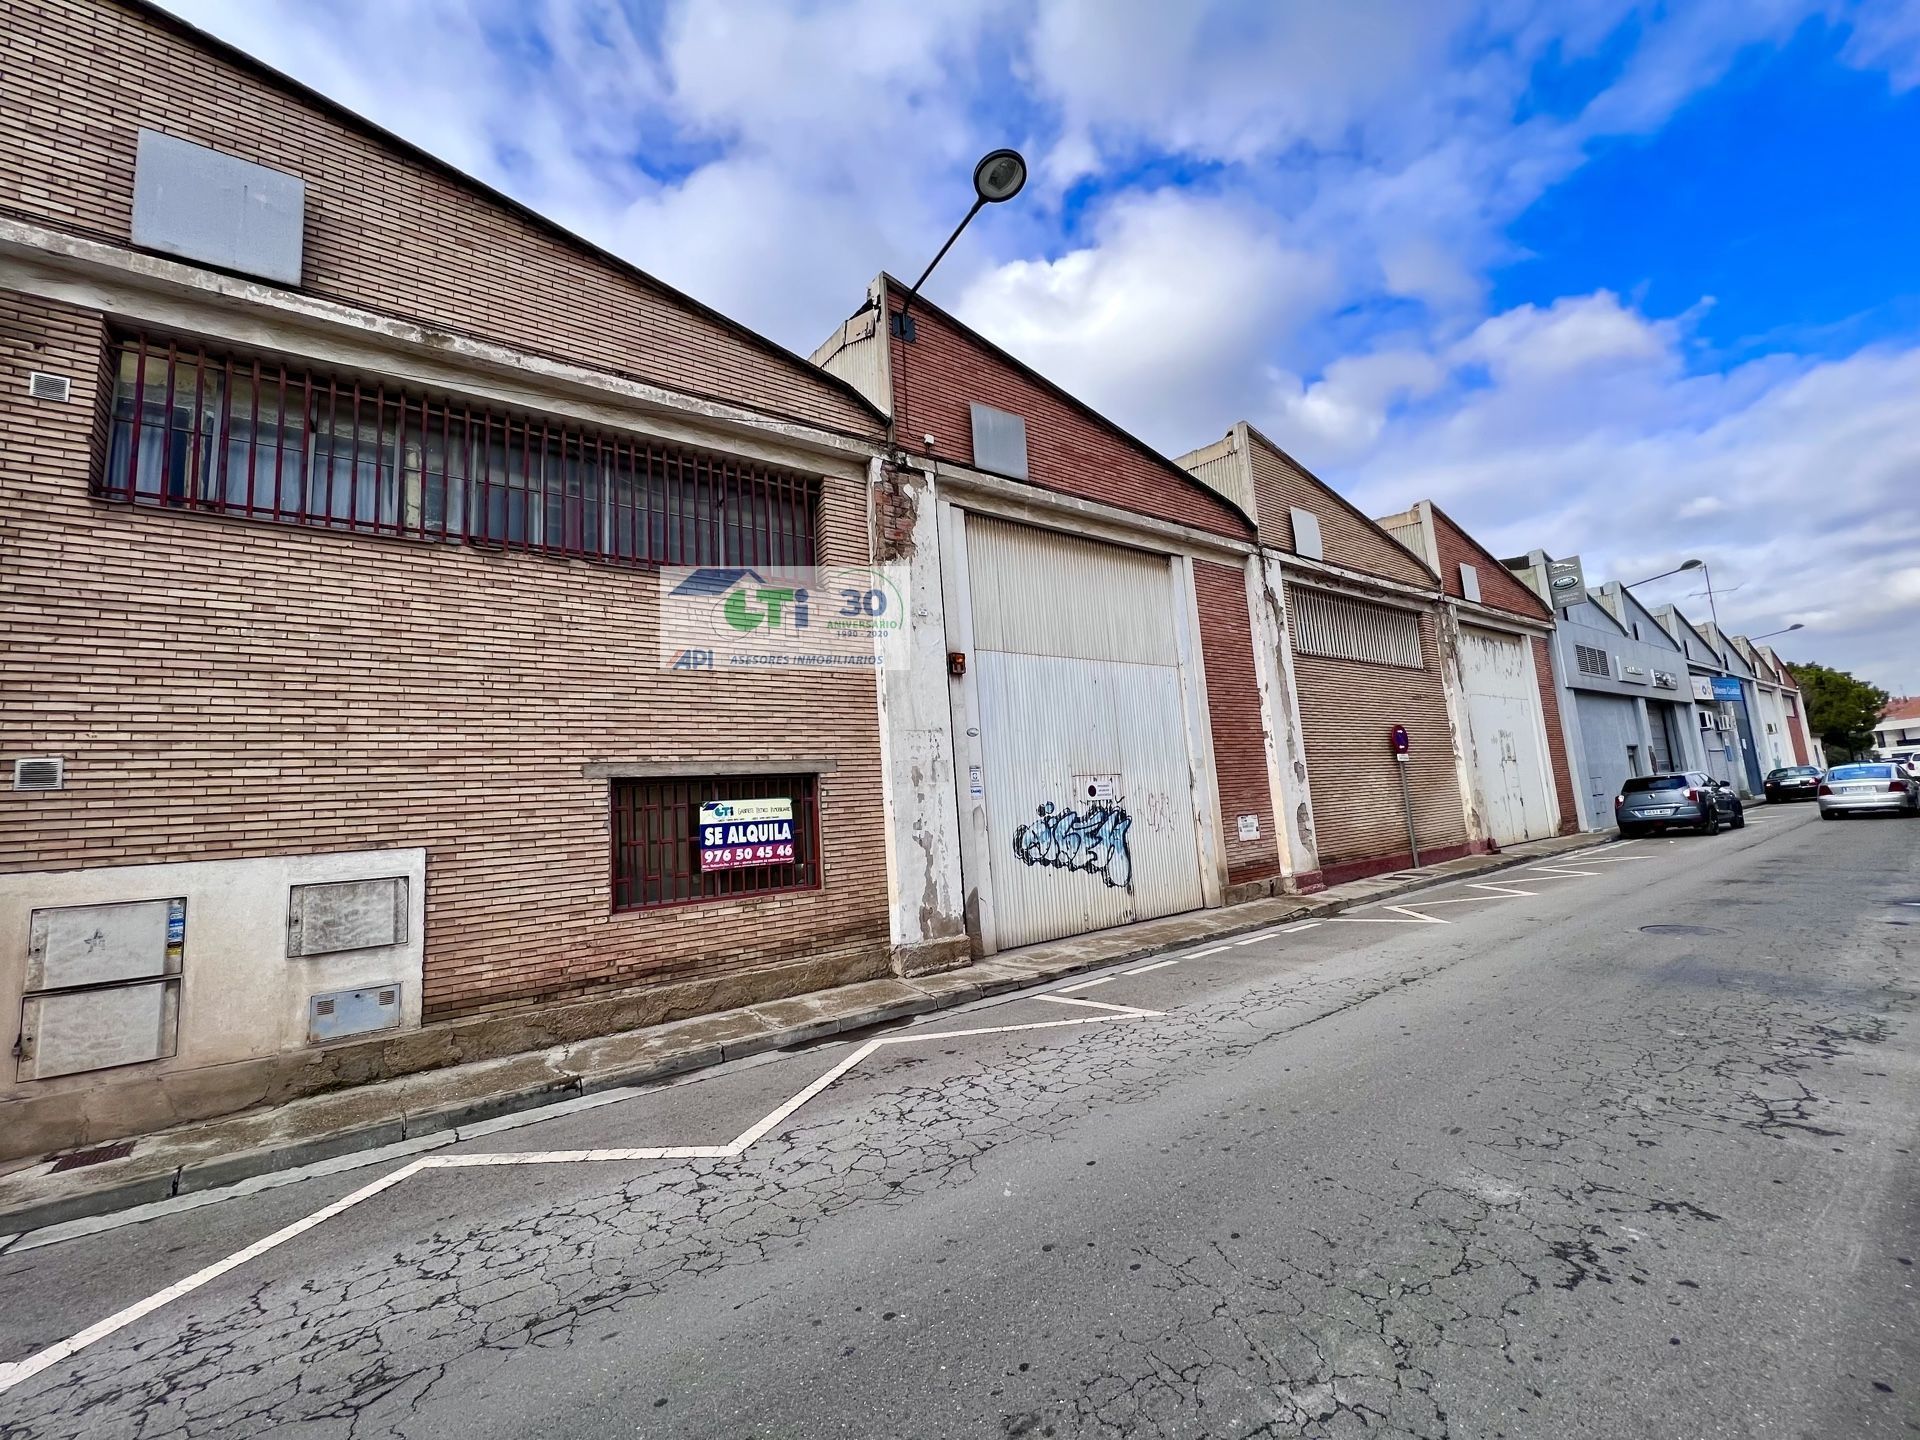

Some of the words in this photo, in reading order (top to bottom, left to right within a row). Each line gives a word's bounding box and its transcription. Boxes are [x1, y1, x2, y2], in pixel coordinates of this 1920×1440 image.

[704, 827, 723, 846] SE
[727, 823, 792, 843] ALQUILA
[704, 849, 731, 863] 976
[735, 848, 753, 860] 50
[756, 846, 773, 858] 45
[776, 844, 793, 856] 46
